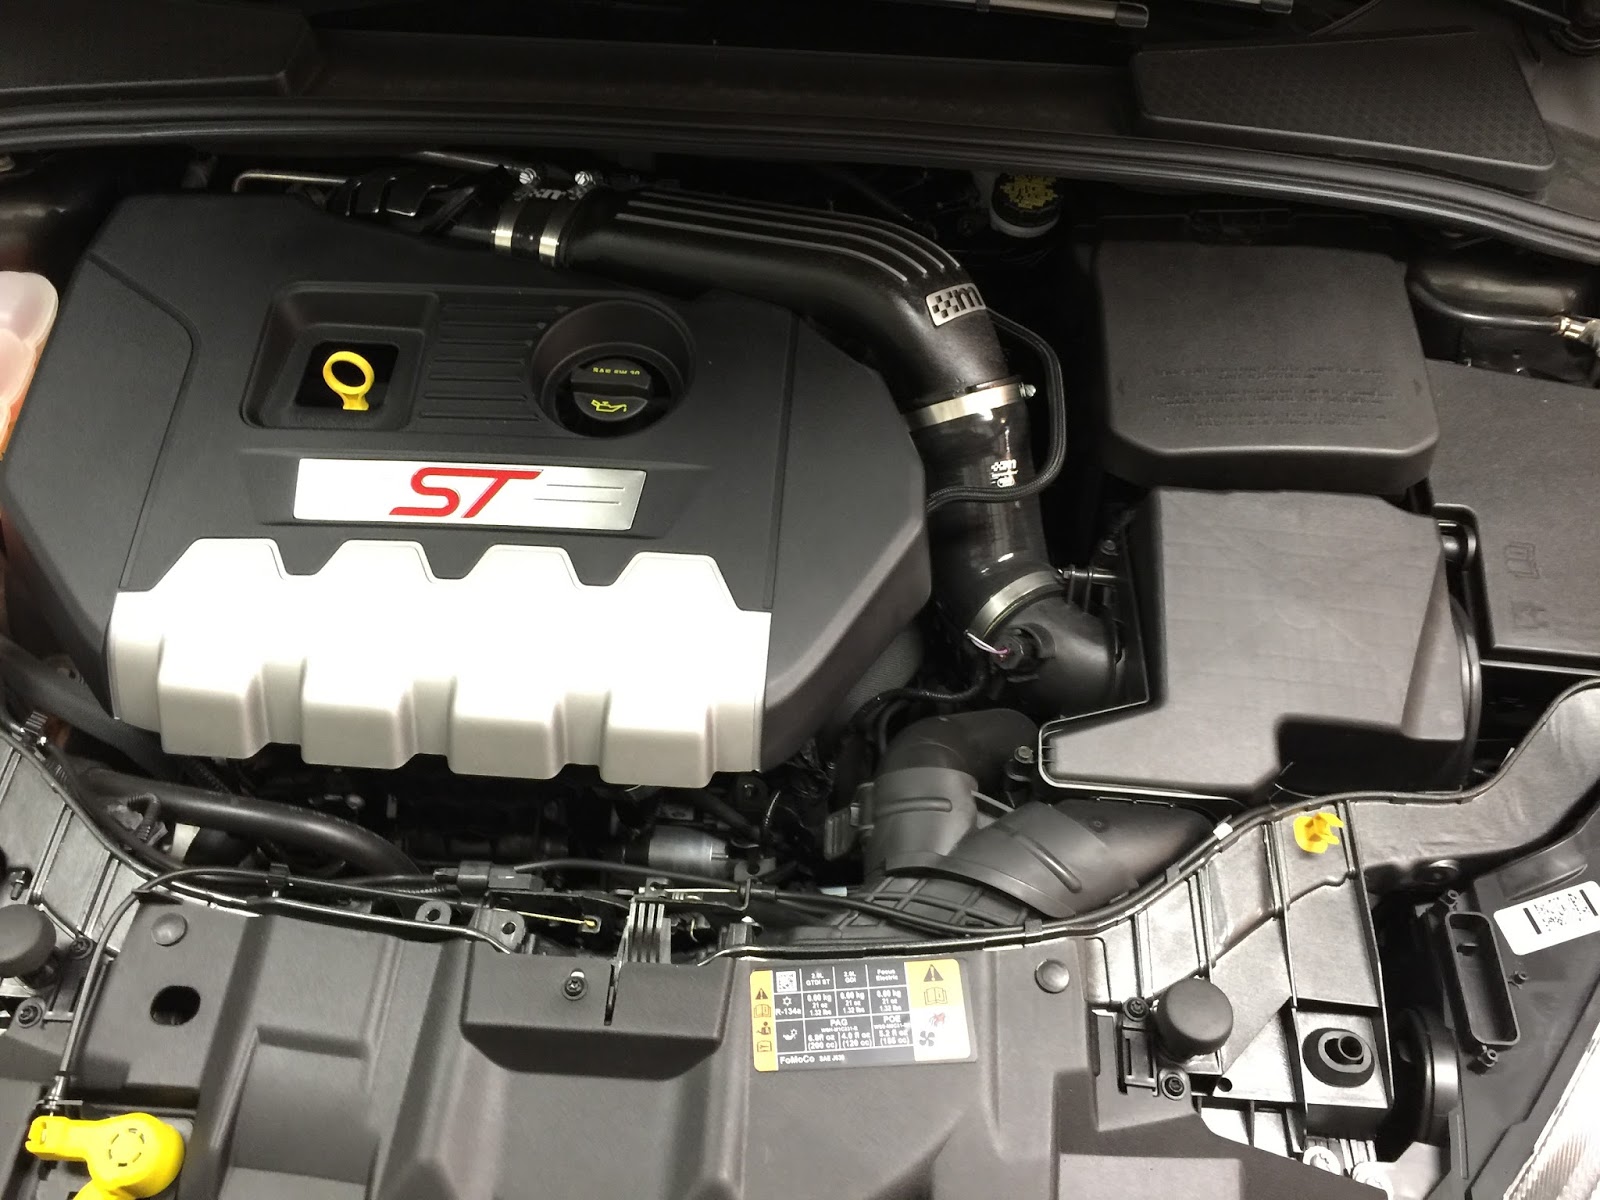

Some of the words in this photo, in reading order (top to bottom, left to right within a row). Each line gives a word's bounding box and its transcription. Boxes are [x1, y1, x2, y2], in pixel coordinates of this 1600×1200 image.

[388, 466, 544, 519] ST
[775, 1007, 802, 1016] R-134a
[829, 1019, 849, 1027] PAG
[882, 1015, 901, 1023] POE
[825, 1041, 838, 1050] cc)
[860, 1039, 872, 1048] cc)
[779, 1055, 815, 1065] FoMoCo
